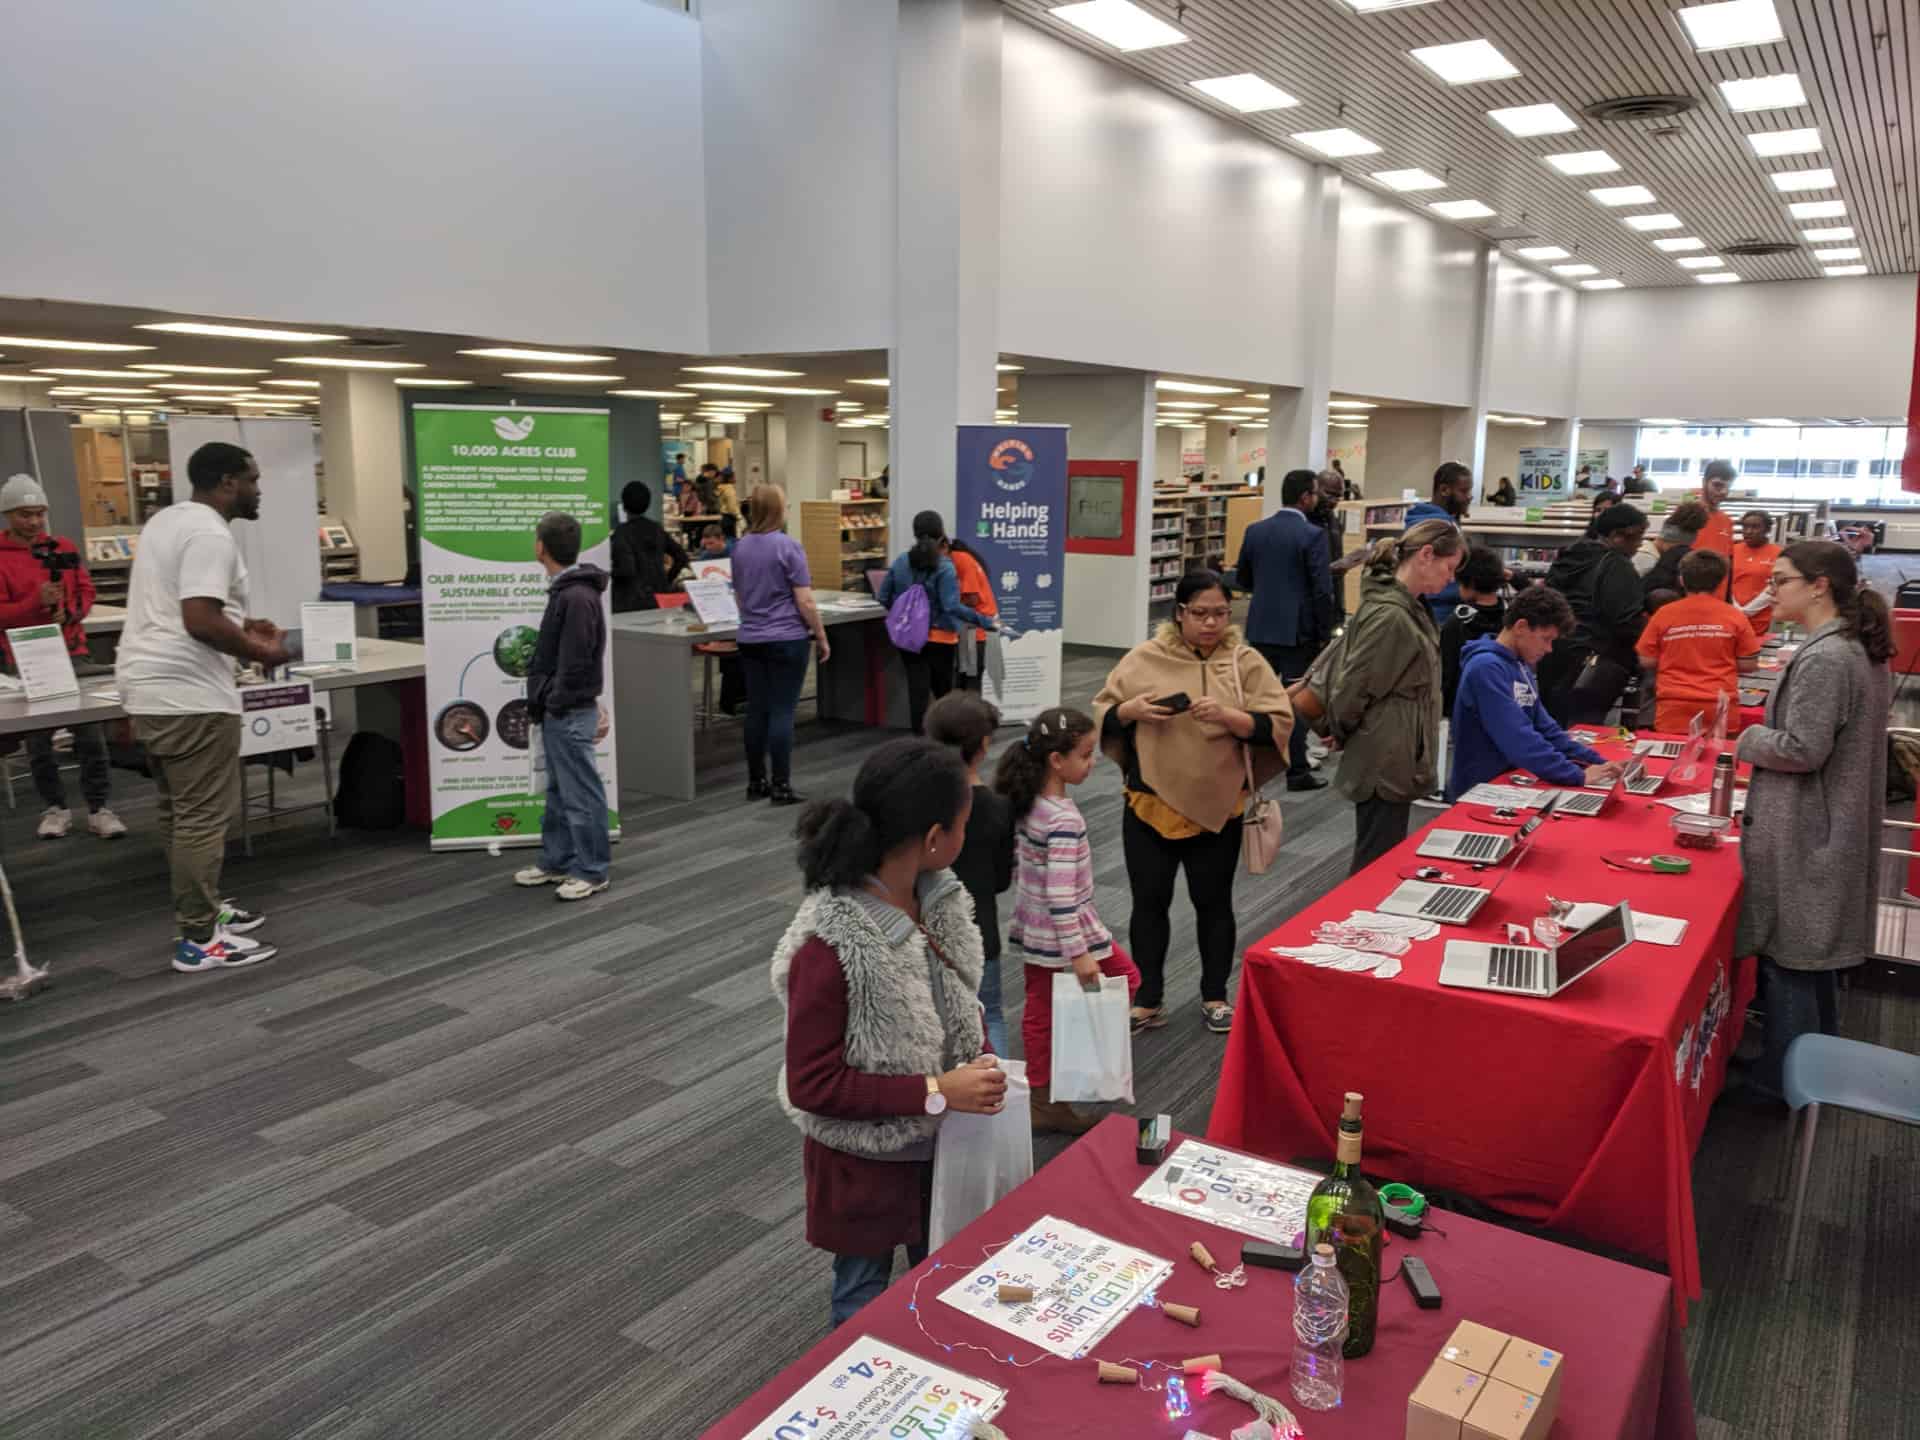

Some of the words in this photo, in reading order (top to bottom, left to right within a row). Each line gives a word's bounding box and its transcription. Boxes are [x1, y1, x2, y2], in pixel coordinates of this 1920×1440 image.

[452, 445, 497, 457] 10,000
[501, 447, 542, 457] ACRES
[544, 447, 576, 458] CLUB
[1520, 473, 1562, 490] KIDS
[981, 501, 1048, 523] Helping
[993, 521, 1048, 538] Hands
[427, 574, 454, 584] OUR
[458, 574, 516, 584] MEMBERS
[520, 574, 541, 583] ARE
[1024, 1228, 1061, 1250] $5
[1081, 1271, 1101, 1283] or
[1093, 1259, 1117, 1273] 10
[973, 1266, 1012, 1290] $6
[1066, 1282, 1090, 1297] 20
[1086, 1280, 1129, 1309] LED
[1034, 1295, 1075, 1325] LEDs
[1040, 1303, 1101, 1346] Lights
[844, 1351, 896, 1383] $4
[851, 1364, 910, 1411] Multi-Colour
[882, 1372, 919, 1399] Purple,
[920, 1383, 954, 1405] 30
[842, 1410, 858, 1421] or
[863, 1398, 892, 1419] Pink,
